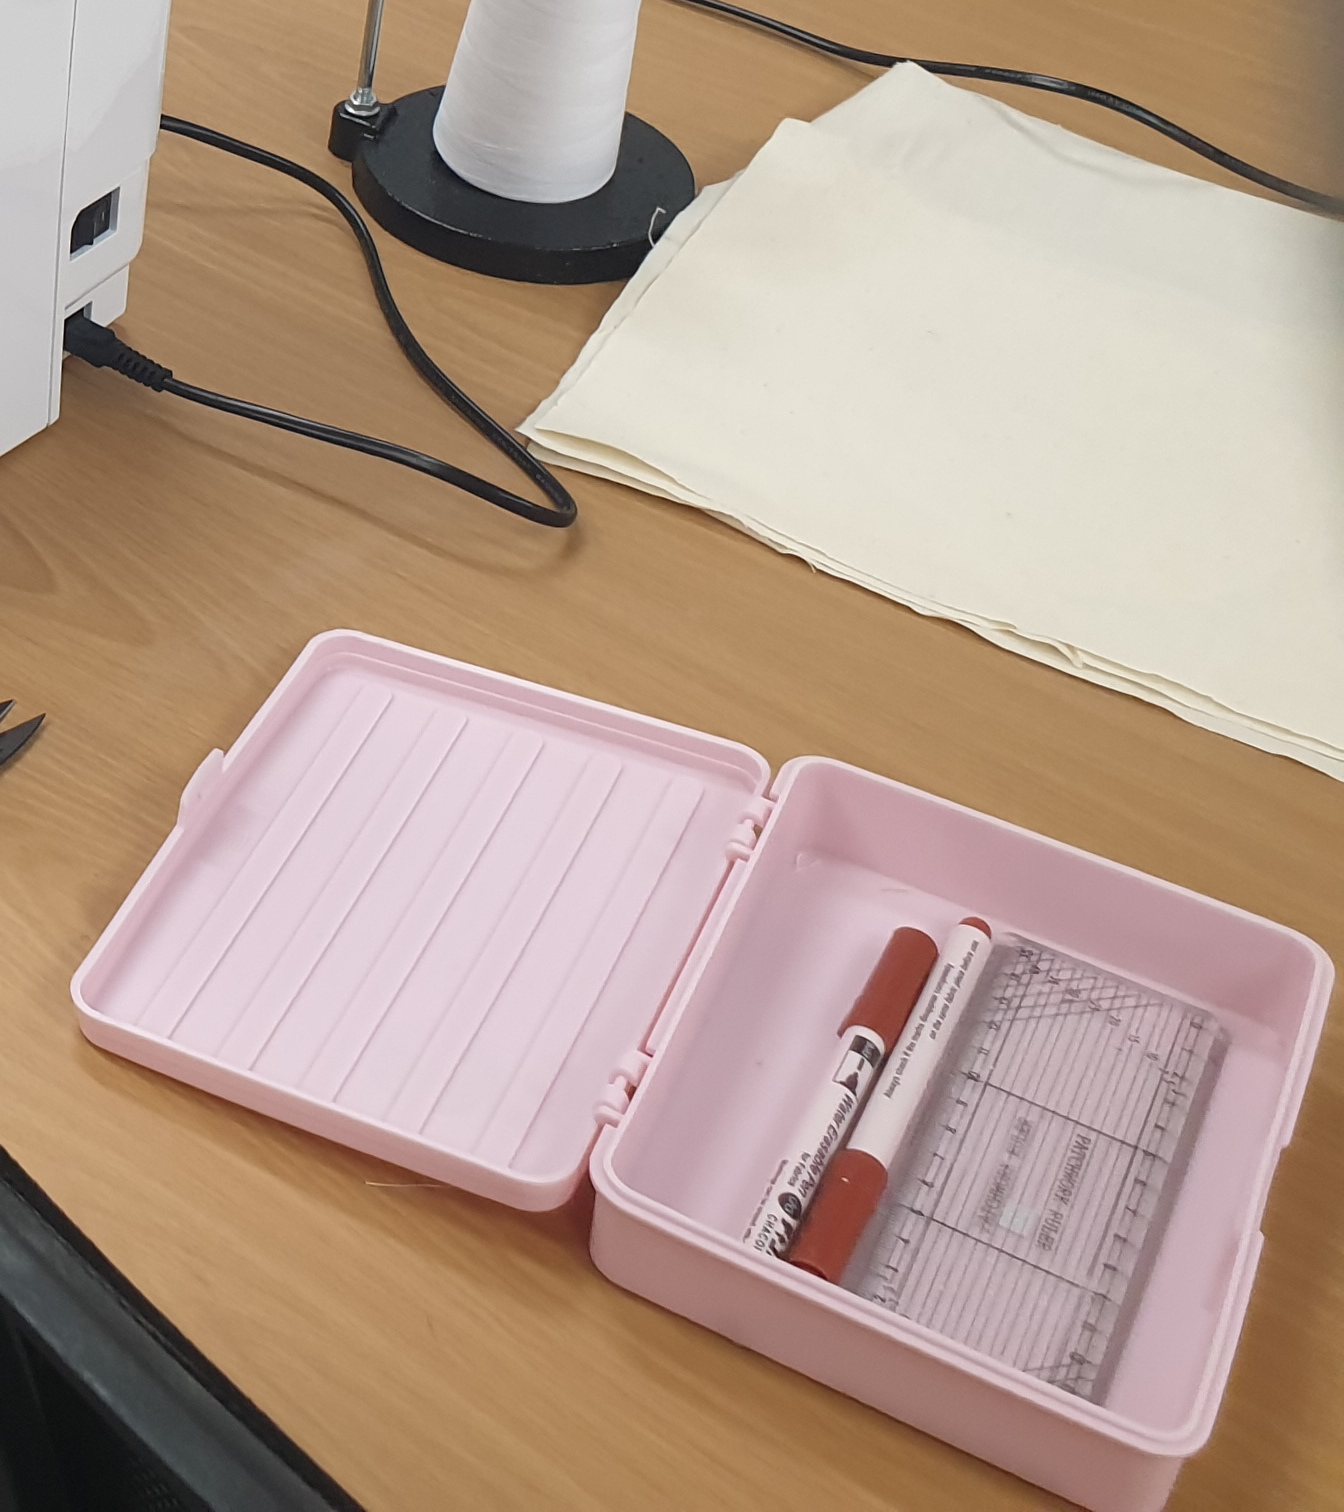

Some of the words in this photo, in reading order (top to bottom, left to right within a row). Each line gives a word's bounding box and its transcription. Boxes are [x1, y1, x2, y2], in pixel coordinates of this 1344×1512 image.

[835, 1093, 856, 1125] Water
[810, 1125, 840, 1175] Erasable
[1061, 1133, 1092, 1206] PATCHWORK
[800, 1170, 817, 1198] Pen
[1036, 1208, 1065, 1252] RULER
